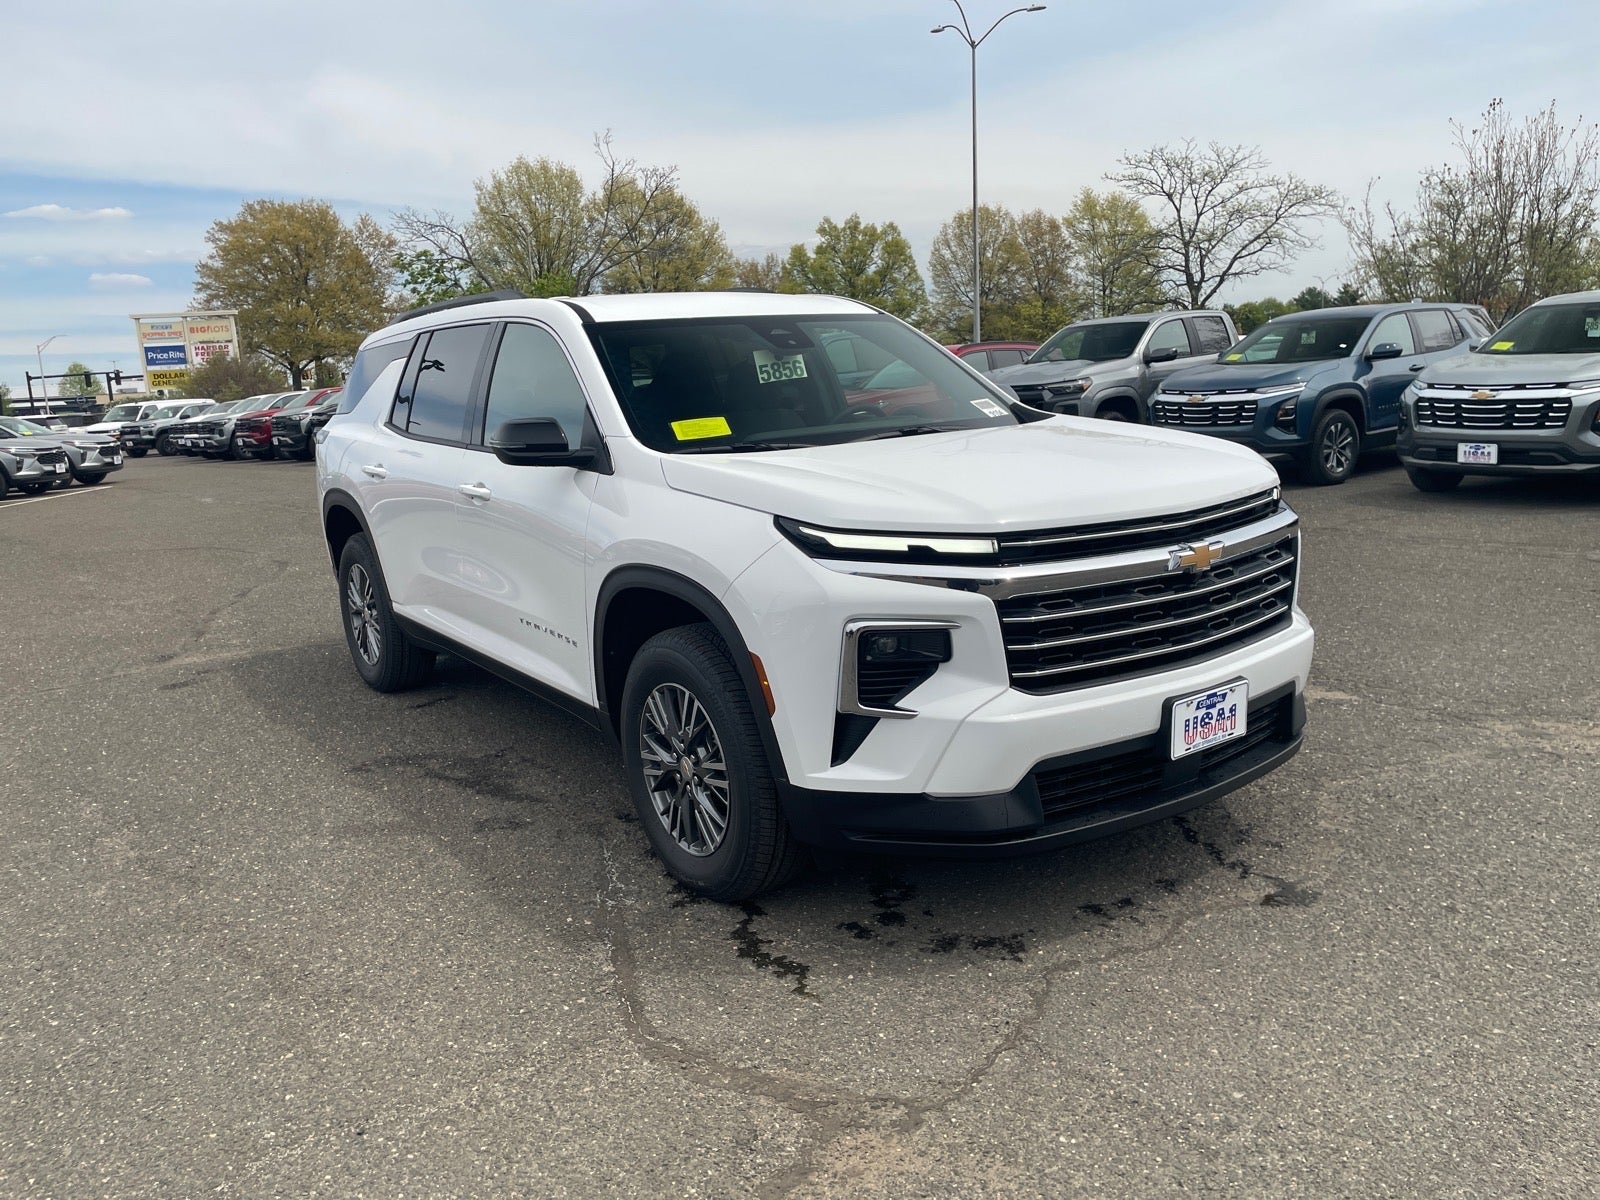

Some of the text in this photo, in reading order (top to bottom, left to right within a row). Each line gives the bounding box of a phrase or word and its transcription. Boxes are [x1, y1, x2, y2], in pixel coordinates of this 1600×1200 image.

[147, 350, 185, 360] Price Rite
[153, 372, 185, 380] DOLLAR
[758, 359, 805, 382] 5856
[519, 617, 578, 648] TRAVERSE
[1199, 695, 1224, 707] CENTRAL
